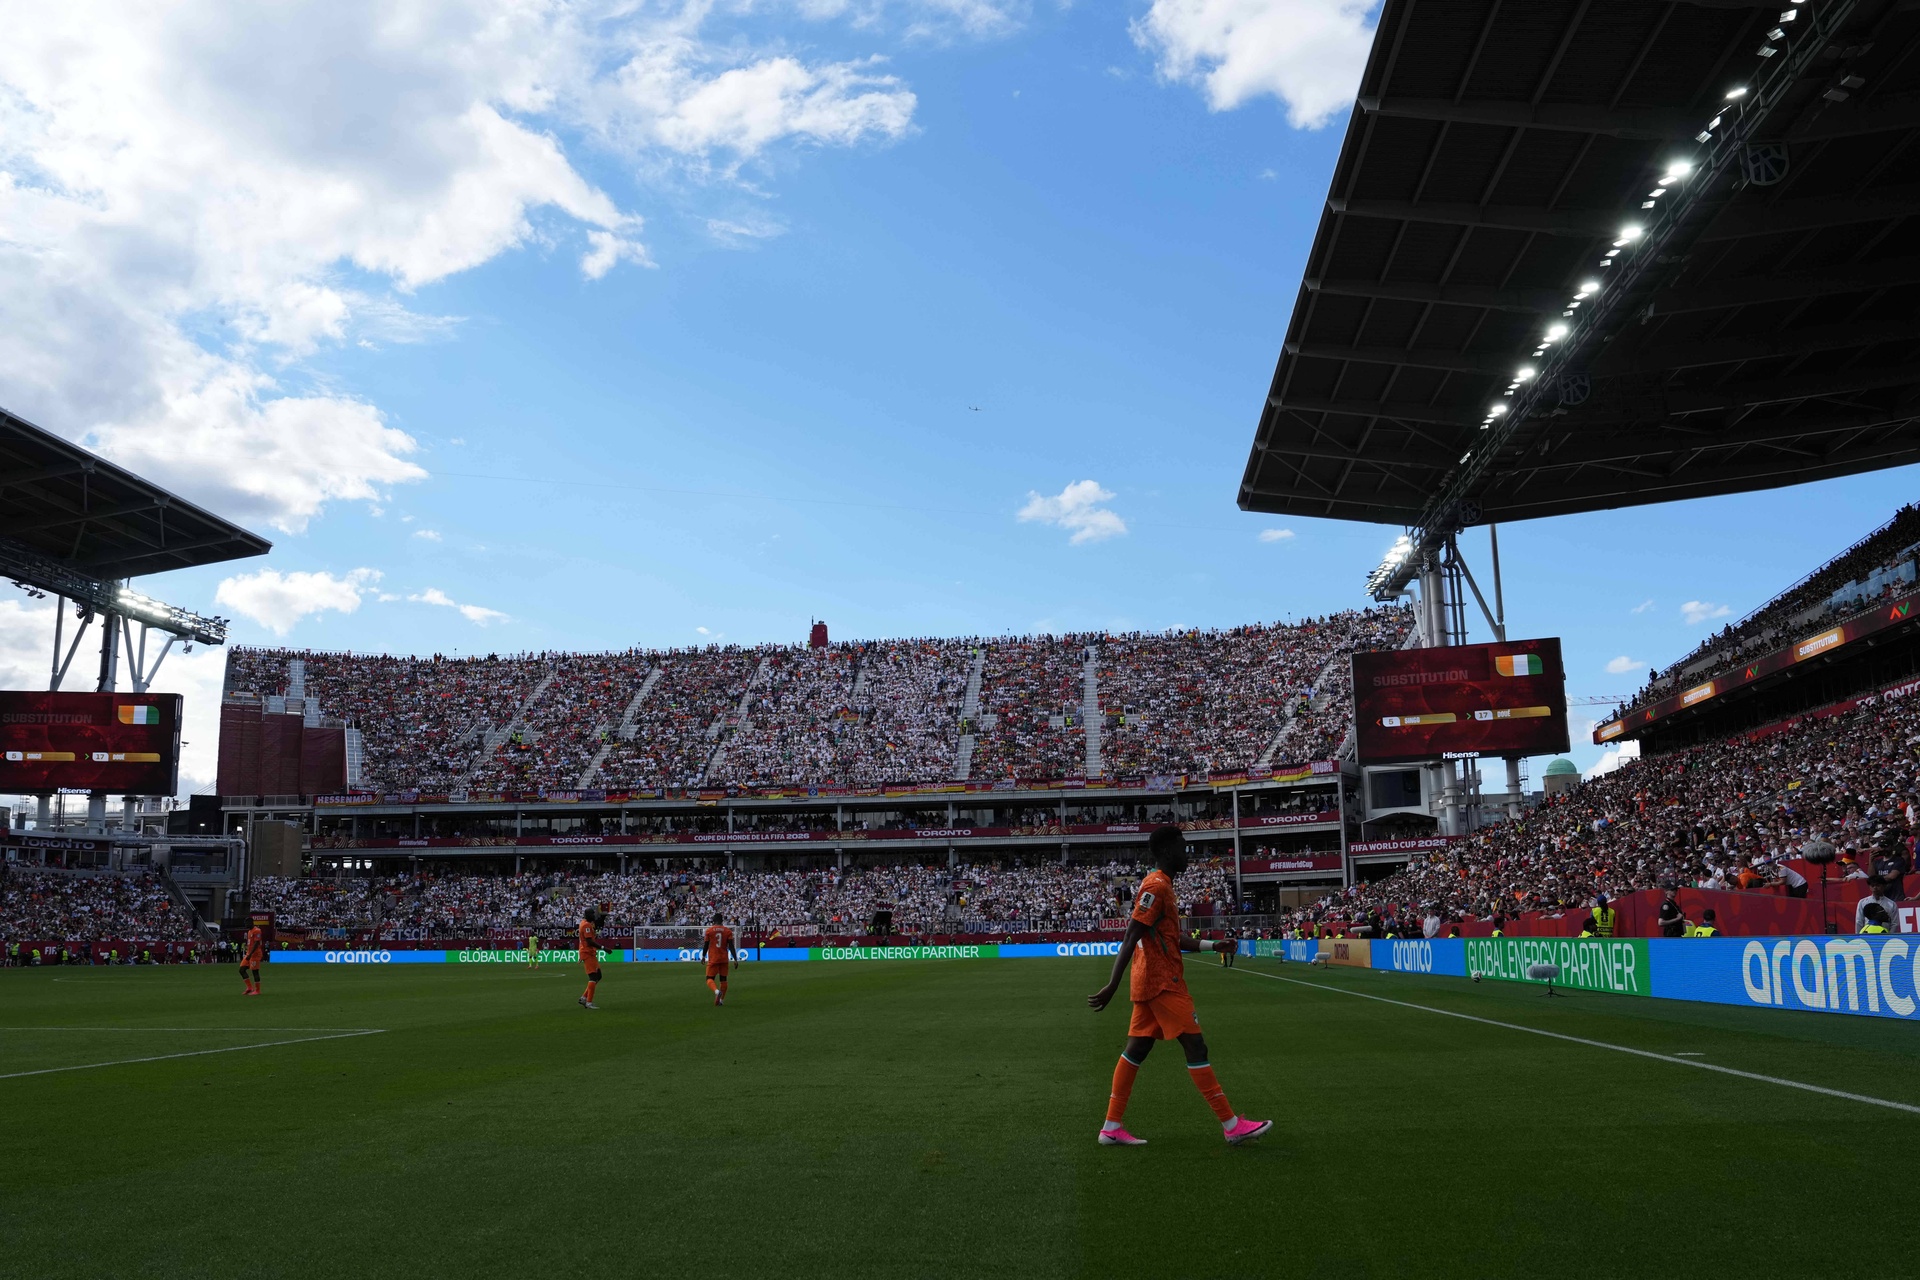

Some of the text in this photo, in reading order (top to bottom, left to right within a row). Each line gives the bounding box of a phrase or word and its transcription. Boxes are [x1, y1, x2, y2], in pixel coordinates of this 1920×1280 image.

[1799, 633, 1838, 656] SUBSTITUTION
[1373, 670, 1469, 687] SUBSTITUTION
[1683, 686, 1711, 703] SUBSTITUTION
[3, 713, 93, 724] SUBSTITUTION
[1442, 751, 1480, 759] Hisense
[57, 787, 92, 795] Hisense
[317, 794, 373, 804] HESSENMOB
[1260, 814, 1318, 824] TORONTO
[694, 834, 716, 842] COUPE
[915, 829, 972, 837] TORONTO
[20, 837, 96, 850] TORONTO
[1350, 838, 1447, 852] FIFA WORLD CUP 2026
[1270, 861, 1313, 869] #FIFAWorldCup
[384, 928, 429, 940] ETSCH
[715, 932, 722, 948] 3
[44, 946, 58, 955] FIF
[325, 950, 391, 963] aramco
[459, 951, 503, 963] GLOBAL
[553, 949, 607, 962] PARTR
[822, 946, 979, 960] GLOBAL ENERGY PARTNER
[1393, 940, 1432, 973] aramco
[1468, 940, 1638, 992] GLOBAL ENERGY PARTNER
